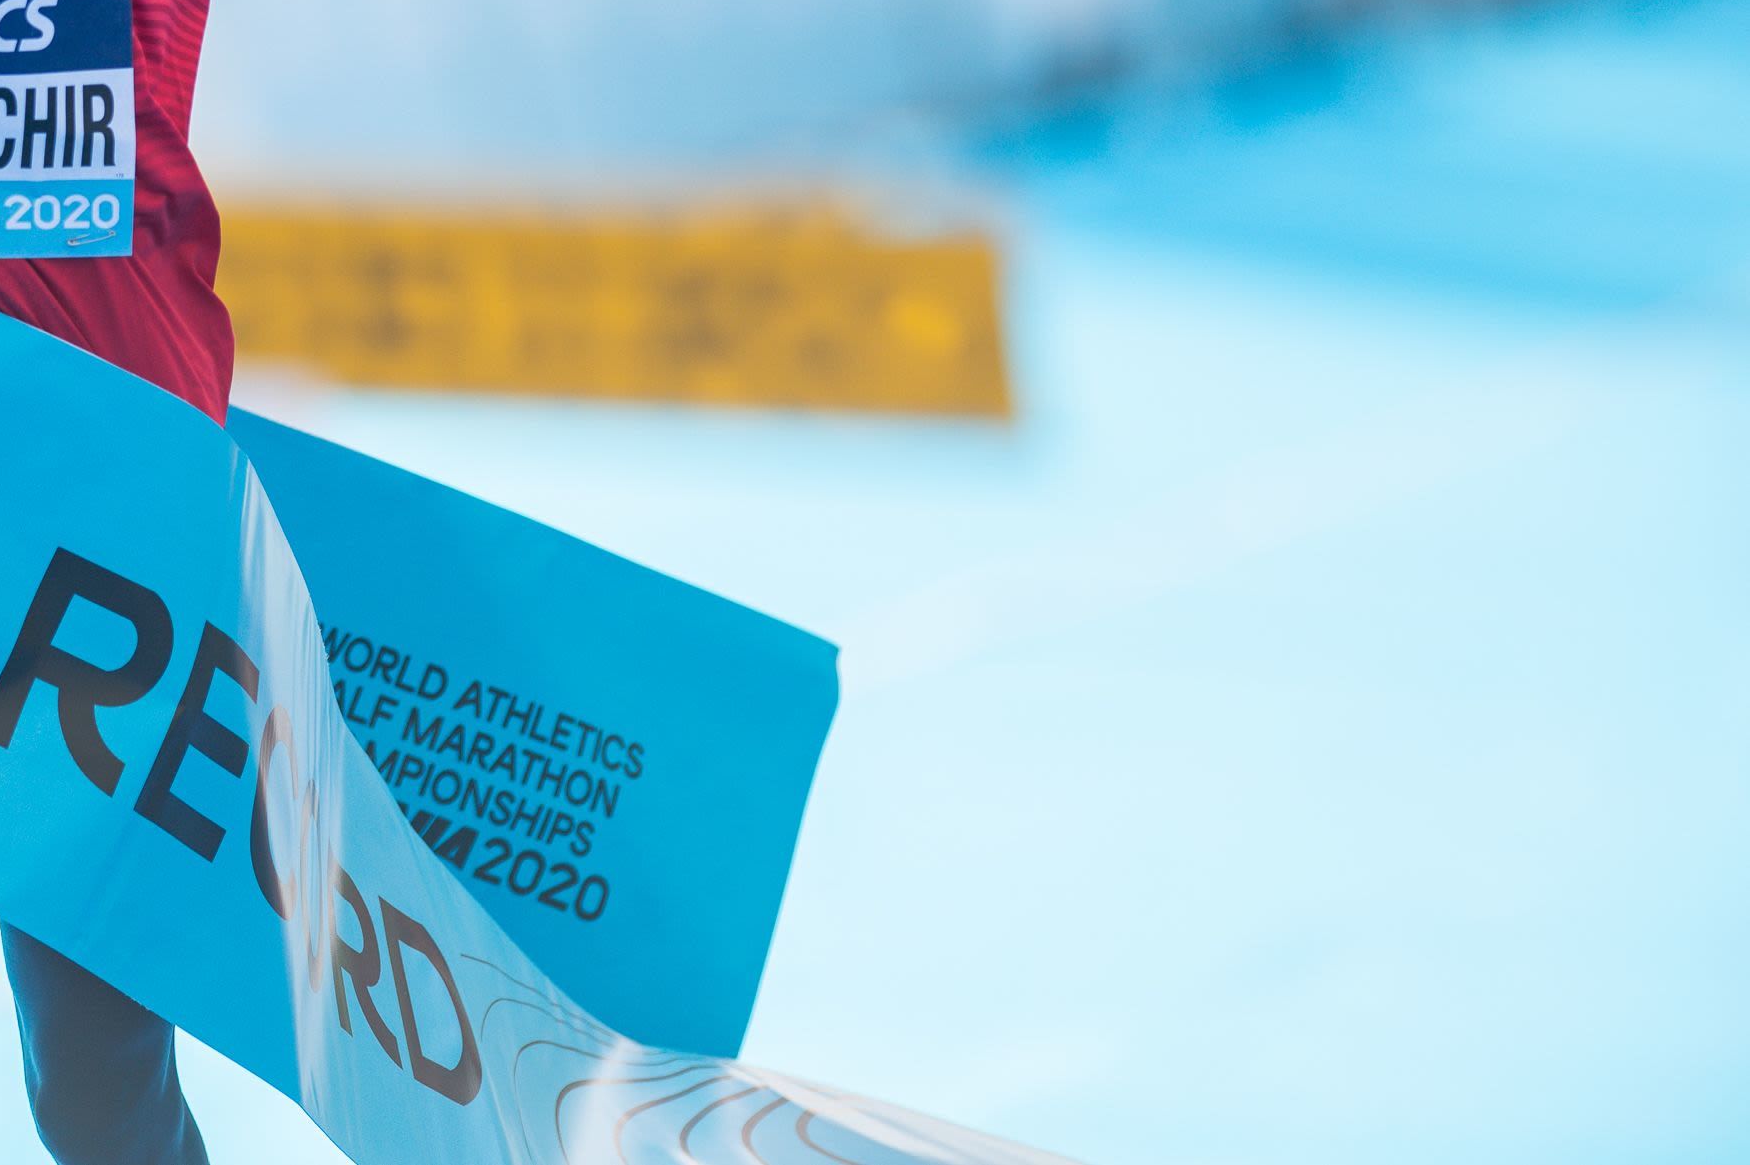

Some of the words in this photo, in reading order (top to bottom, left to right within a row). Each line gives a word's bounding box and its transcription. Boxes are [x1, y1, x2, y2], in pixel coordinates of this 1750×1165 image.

[5, 194, 120, 230] 2020
[318, 623, 449, 700] WORLD
[452, 679, 645, 779] ATHLETICS
[402, 707, 621, 819] MARATHON
[472, 838, 610, 922] 2020
